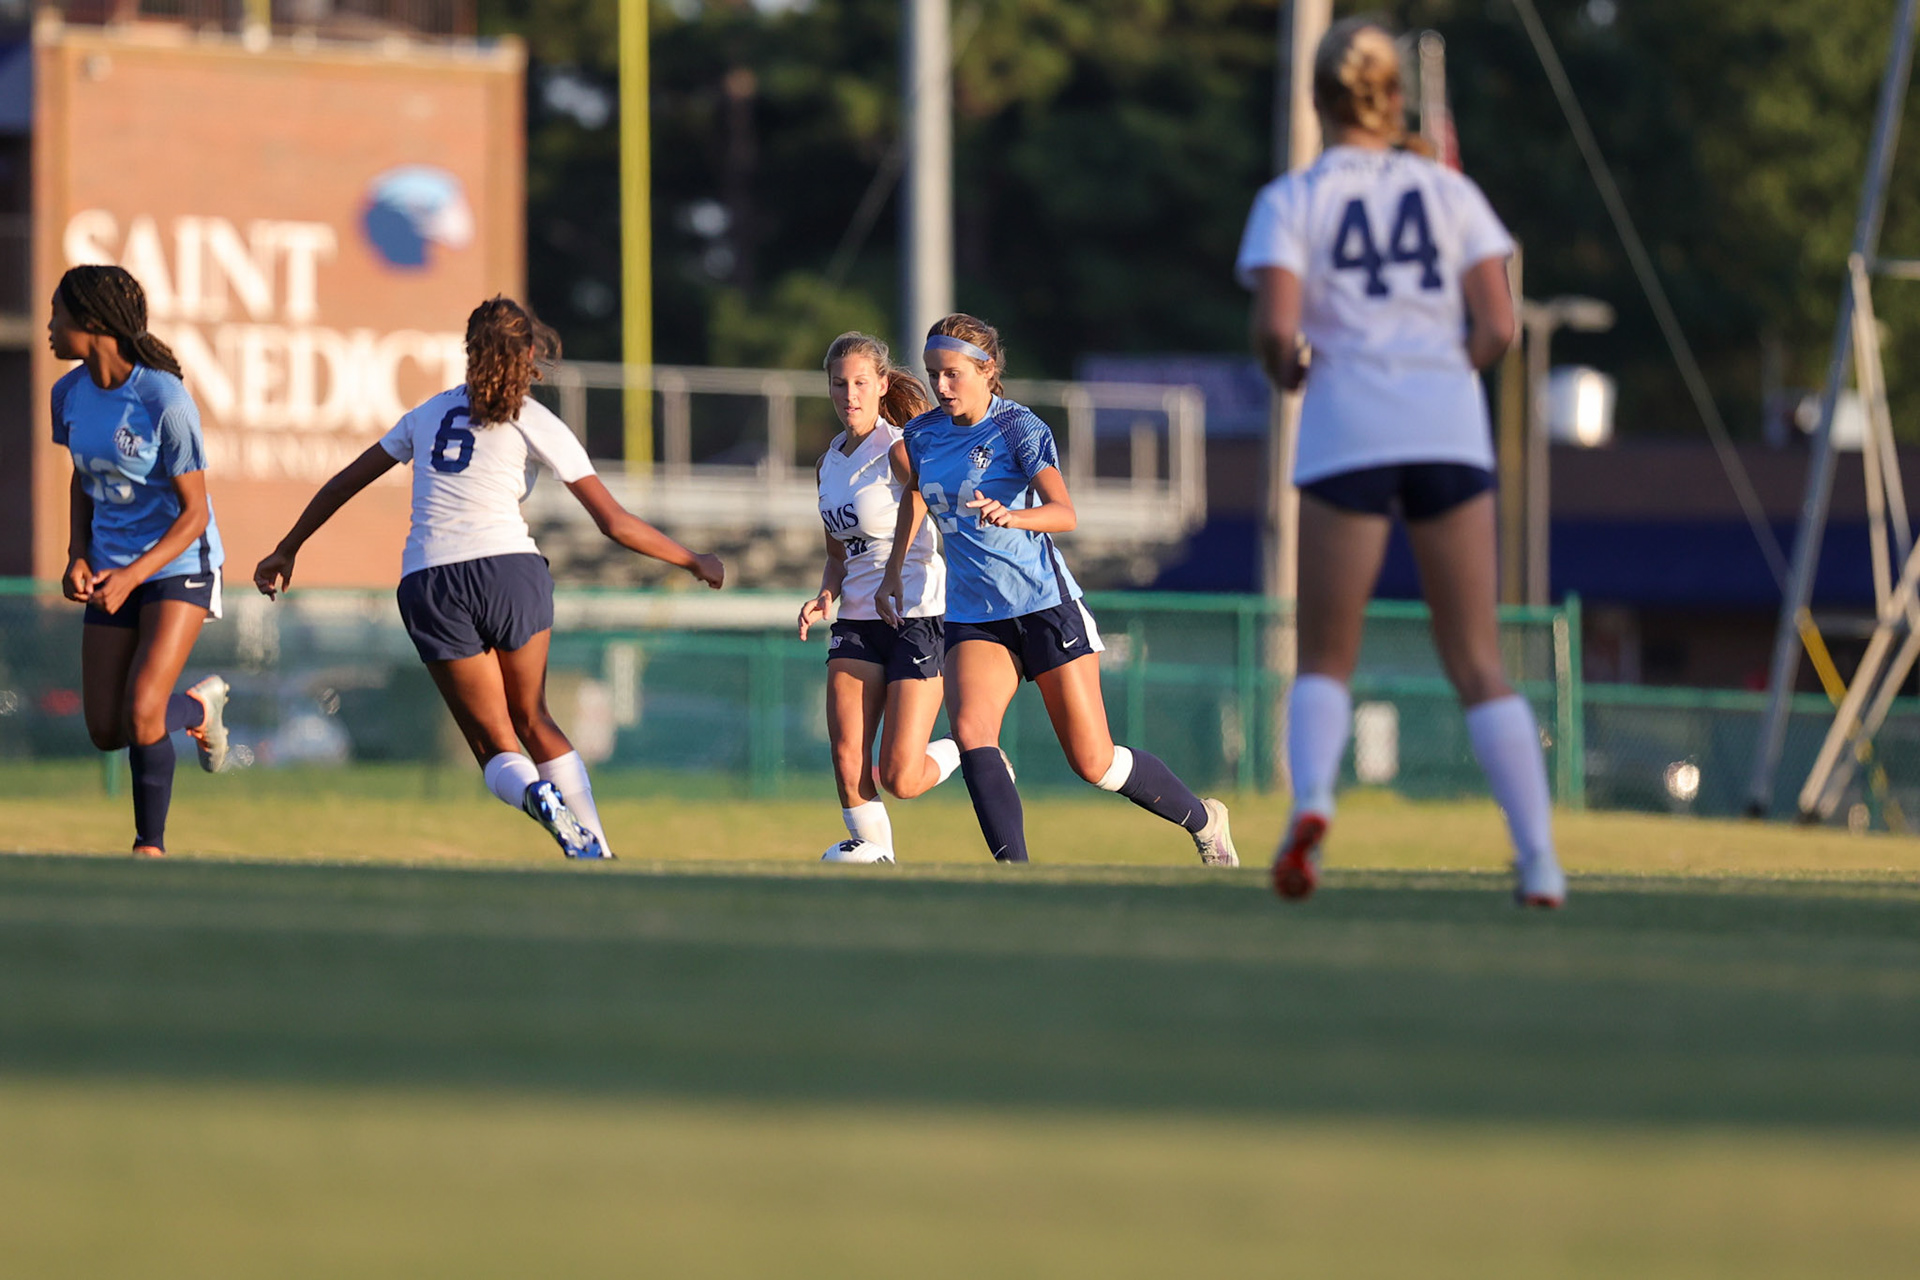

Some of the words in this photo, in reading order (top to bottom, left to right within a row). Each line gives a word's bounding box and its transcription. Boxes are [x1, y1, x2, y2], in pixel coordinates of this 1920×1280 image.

[63, 209, 337, 323] SAINT
[1333, 188, 1442, 296] 44
[431, 406, 476, 474] 6
[74, 453, 136, 505] 13
[922, 479, 993, 535] 24
[821, 503, 859, 533] SMS
